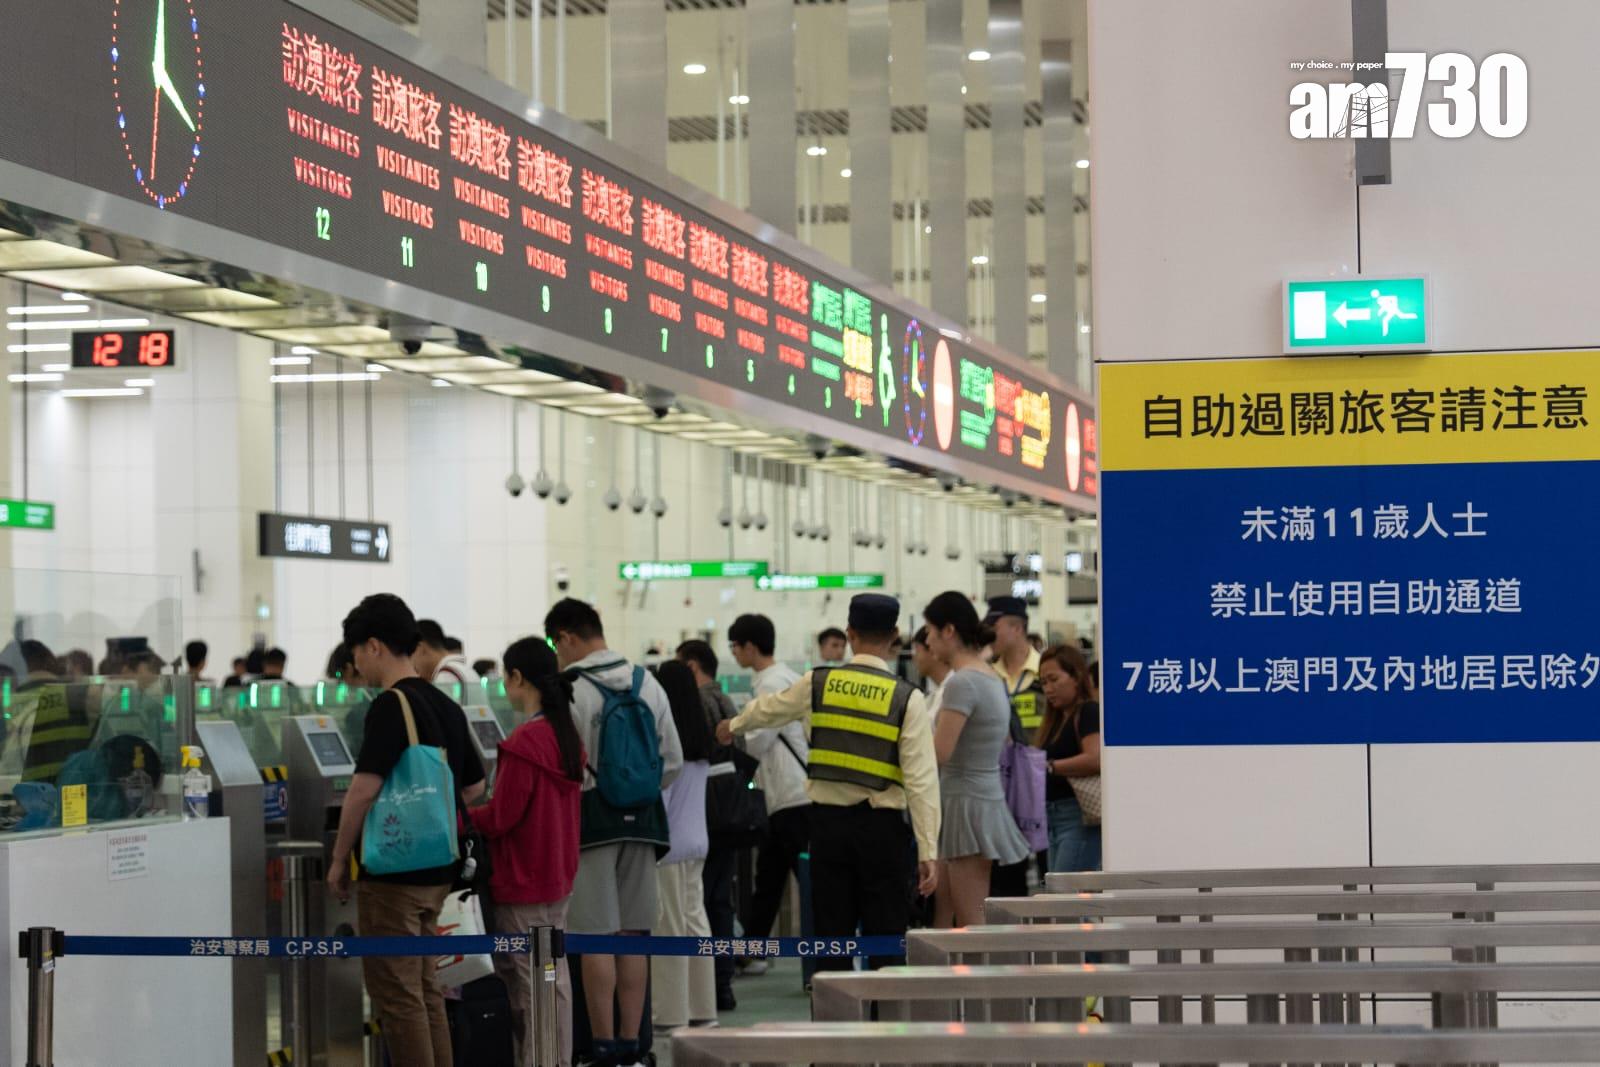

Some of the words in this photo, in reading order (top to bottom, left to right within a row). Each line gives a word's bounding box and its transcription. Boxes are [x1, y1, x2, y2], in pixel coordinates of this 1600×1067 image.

[281, 23, 363, 115] 訪澳旅客
[371, 65, 443, 149] 訪澳旅客
[287, 107, 360, 158] VISITANTES
[448, 102, 512, 181] 訪澳旅客
[294, 156, 352, 199] VISITORS
[376, 144, 440, 190] VISITANTES
[516, 136, 573, 208] 訪澳旅客
[382, 190, 434, 229] VISITORS
[453, 176, 510, 219] VISITANTES
[315, 206, 330, 240] 12
[458, 219, 504, 255] VISITORS
[520, 205, 572, 245] VISITANTES
[401, 236, 413, 267] 11
[525, 244, 567, 279] VISITORS
[584, 232, 633, 270] VISITANTES
[476, 261, 488, 291] 10
[589, 269, 629, 302] VISITORS
[93, 333, 123, 367] 12
[138, 332, 169, 367] 18
[660, 327, 669, 352] 7
[1143, 383, 1589, 439] 自助過關旅客請注意
[1241, 502, 1489, 542] 未滿11歲人士
[1210, 577, 1522, 618] 禁止使用自助通道
[827, 678, 889, 701] SECURITY
[189, 939, 270, 956] 治安警察局
[285, 941, 348, 955] C.P.S.P.
[494, 936, 529, 952] 治安
[697, 939, 780, 956] 治安警察局
[797, 940, 862, 955] C.P.S.P.
